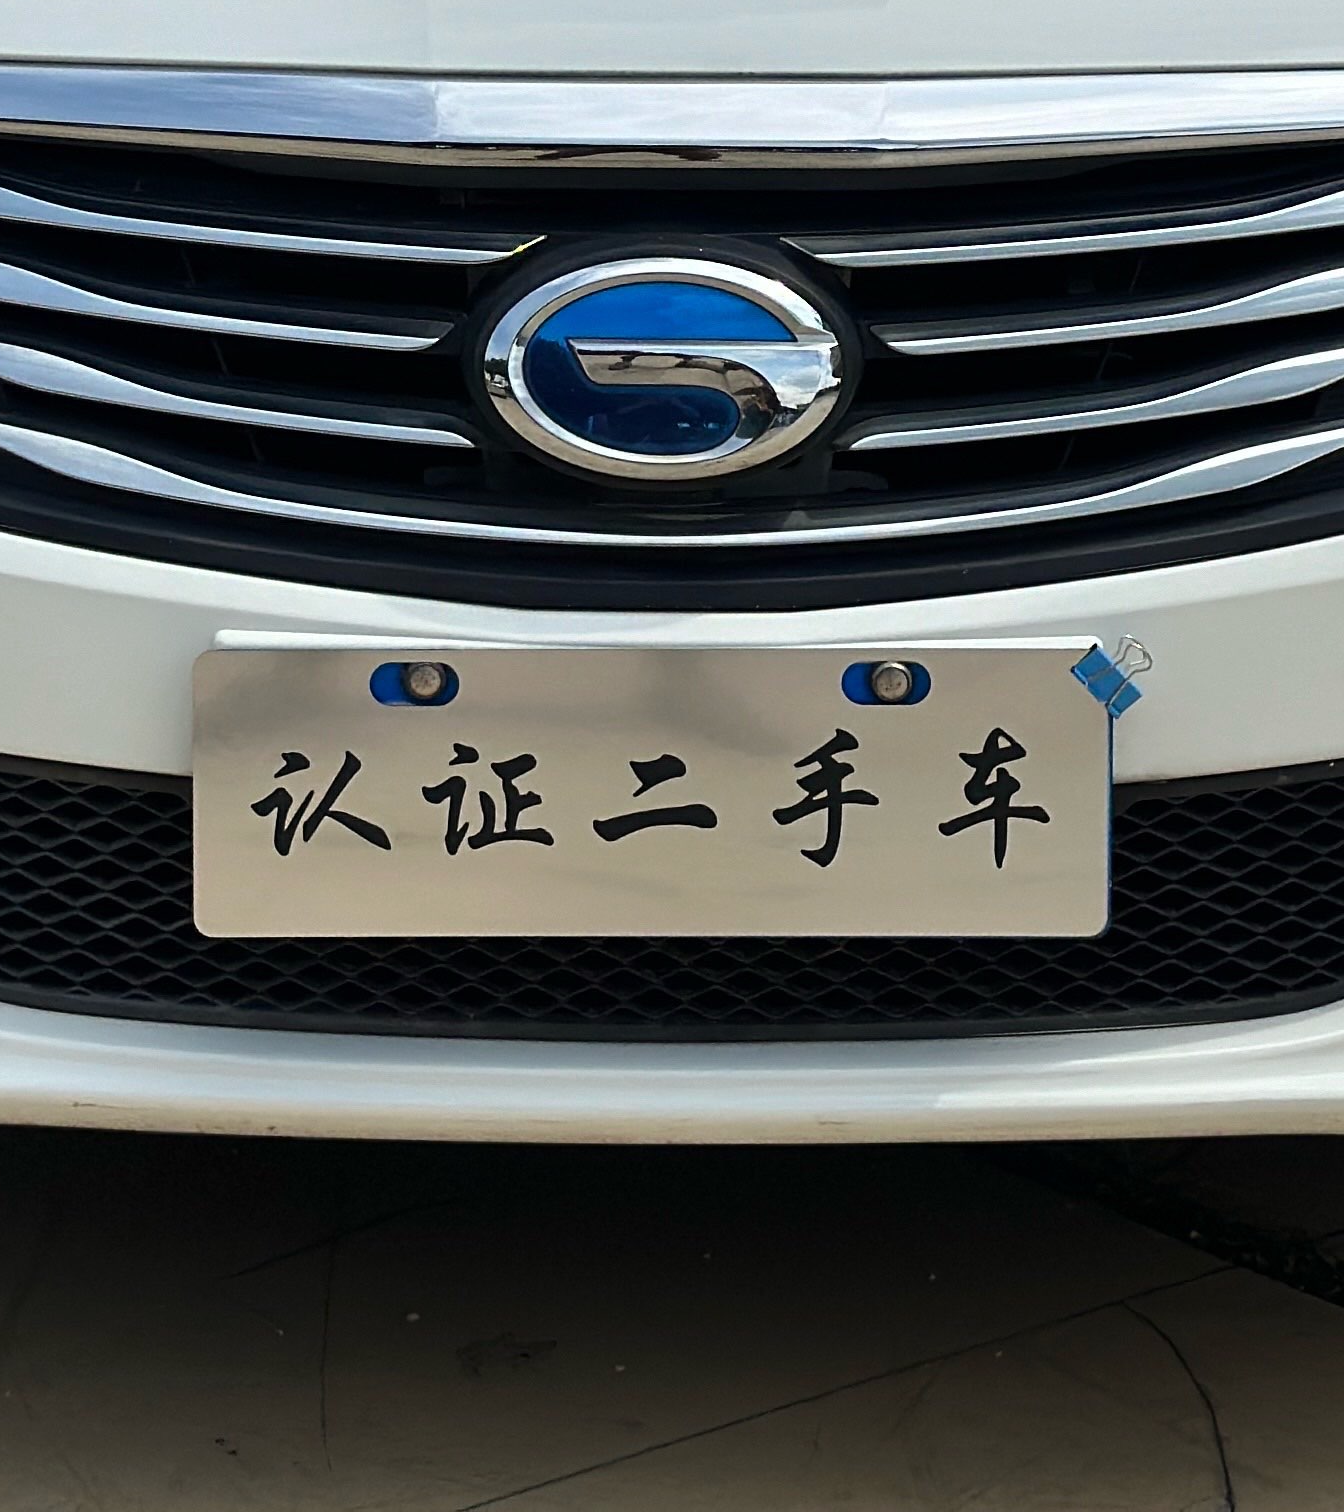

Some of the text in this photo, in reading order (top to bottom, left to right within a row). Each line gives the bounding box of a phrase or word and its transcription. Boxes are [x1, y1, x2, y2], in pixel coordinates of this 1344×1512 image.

[251, 727, 1051, 869] 认证二手车
